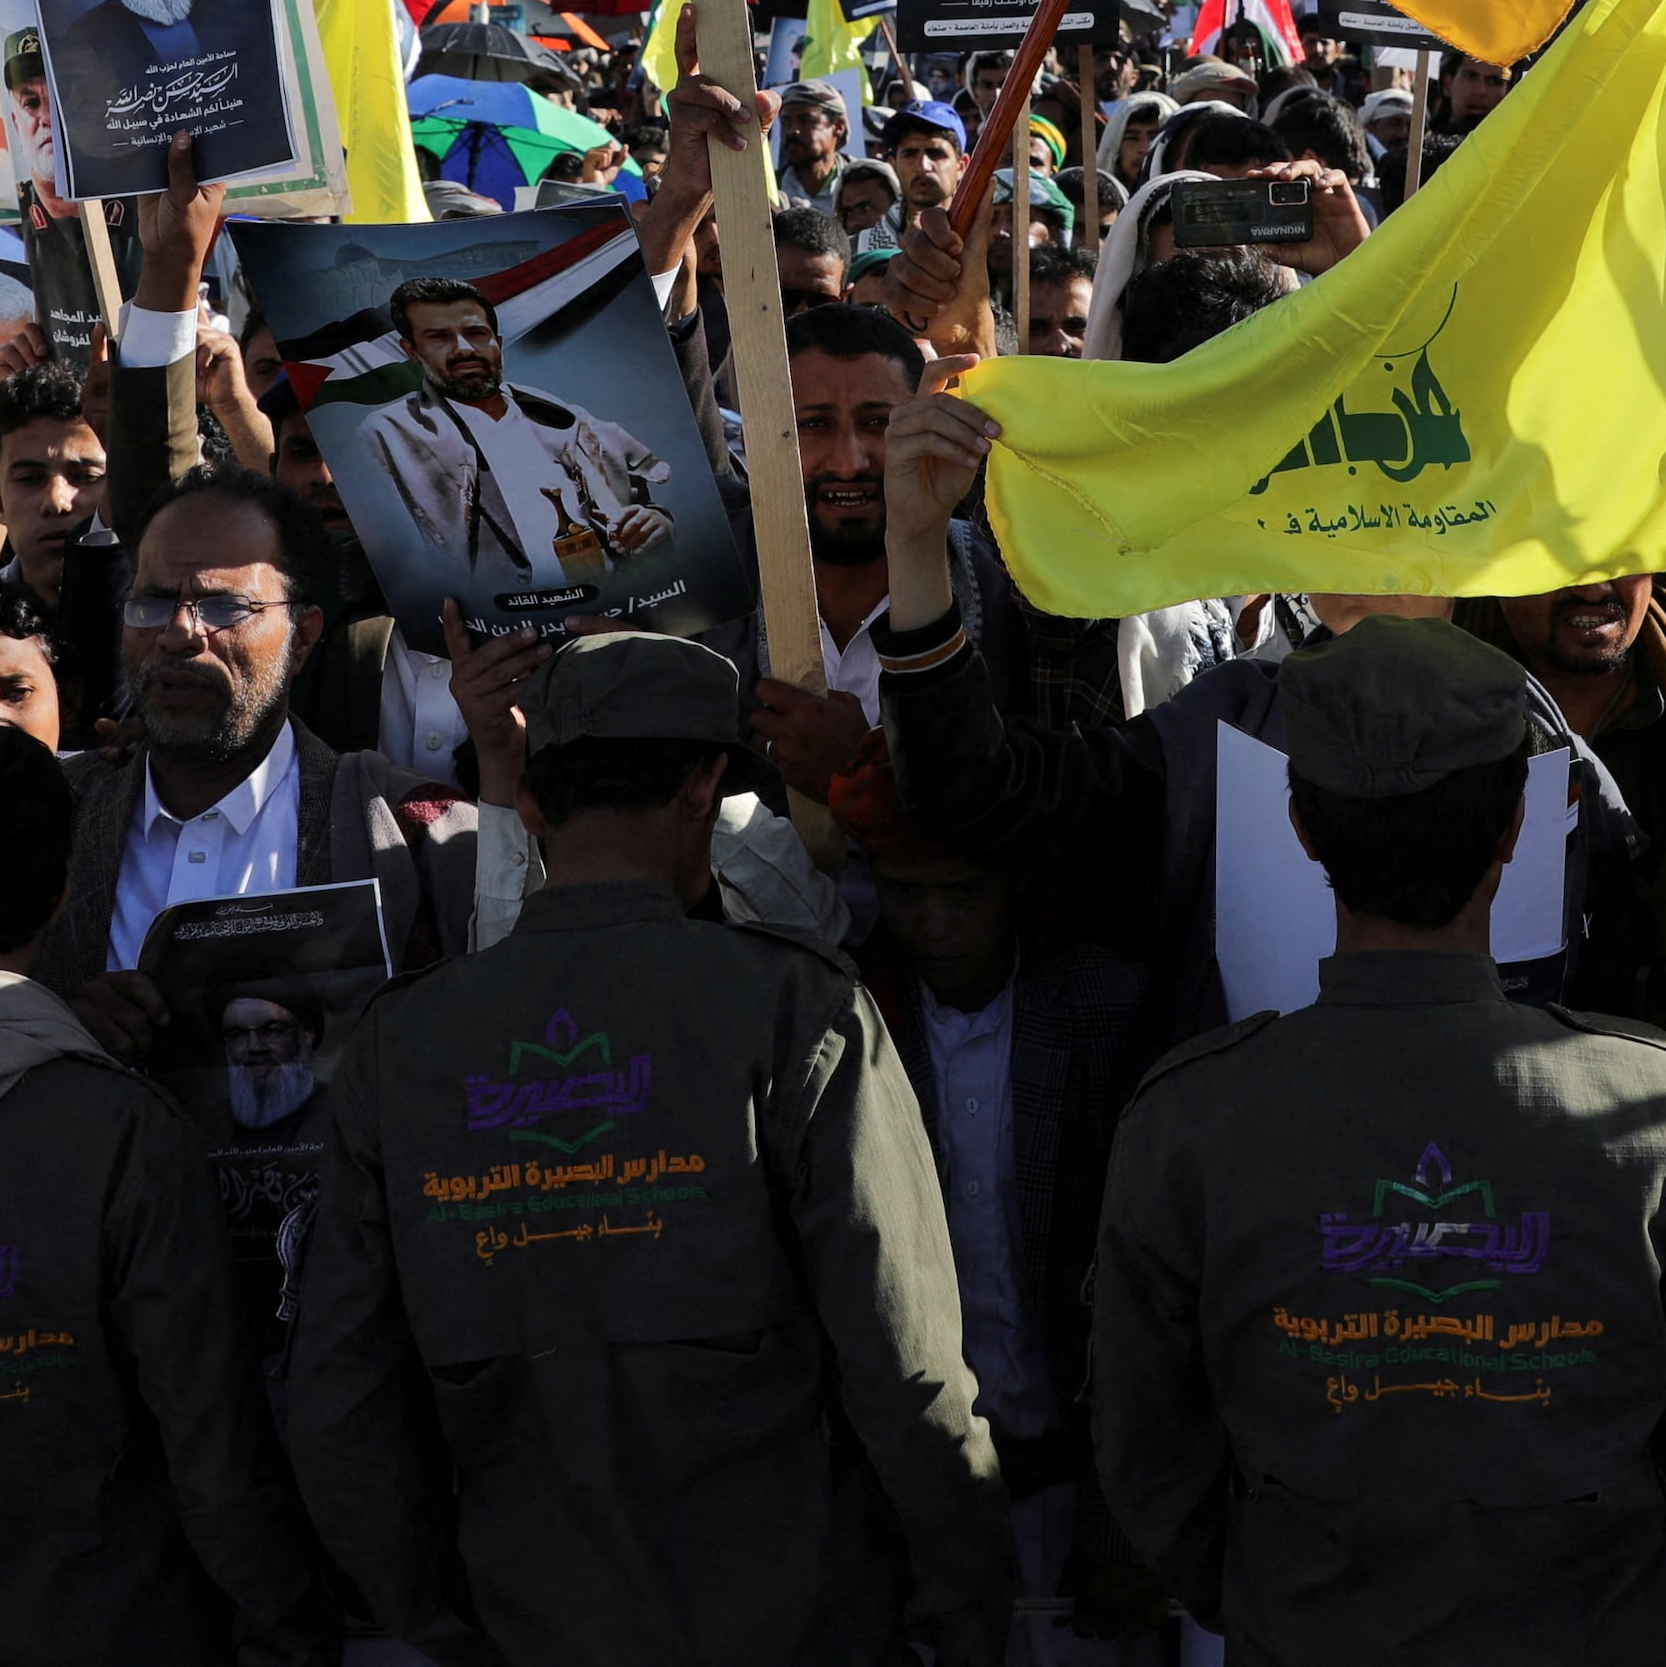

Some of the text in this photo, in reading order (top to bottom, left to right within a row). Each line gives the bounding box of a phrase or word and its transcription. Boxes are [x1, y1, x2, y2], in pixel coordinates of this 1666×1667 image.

[145, 65, 159, 75] الله
[164, 107, 203, 124] الشهادة
[203, 102, 220, 117] لكم
[105, 118, 122, 130] الله
[122, 119, 148, 131] سبيل
[149, 113, 164, 131] في
[1402, 499, 1499, 536] المقاومة
[507, 587, 585, 607] الشهيد القائد
[422, 1149, 707, 1202] مدارس البصيرة التربوية
[513, 1220, 595, 1248] جيل
[597, 1210, 665, 1239] بناء
[1272, 1306, 1605, 1350] مدارس البصيرة التربوية
[1363, 1374, 1460, 1401] جيل
[1463, 1375, 1552, 1407] بناء
